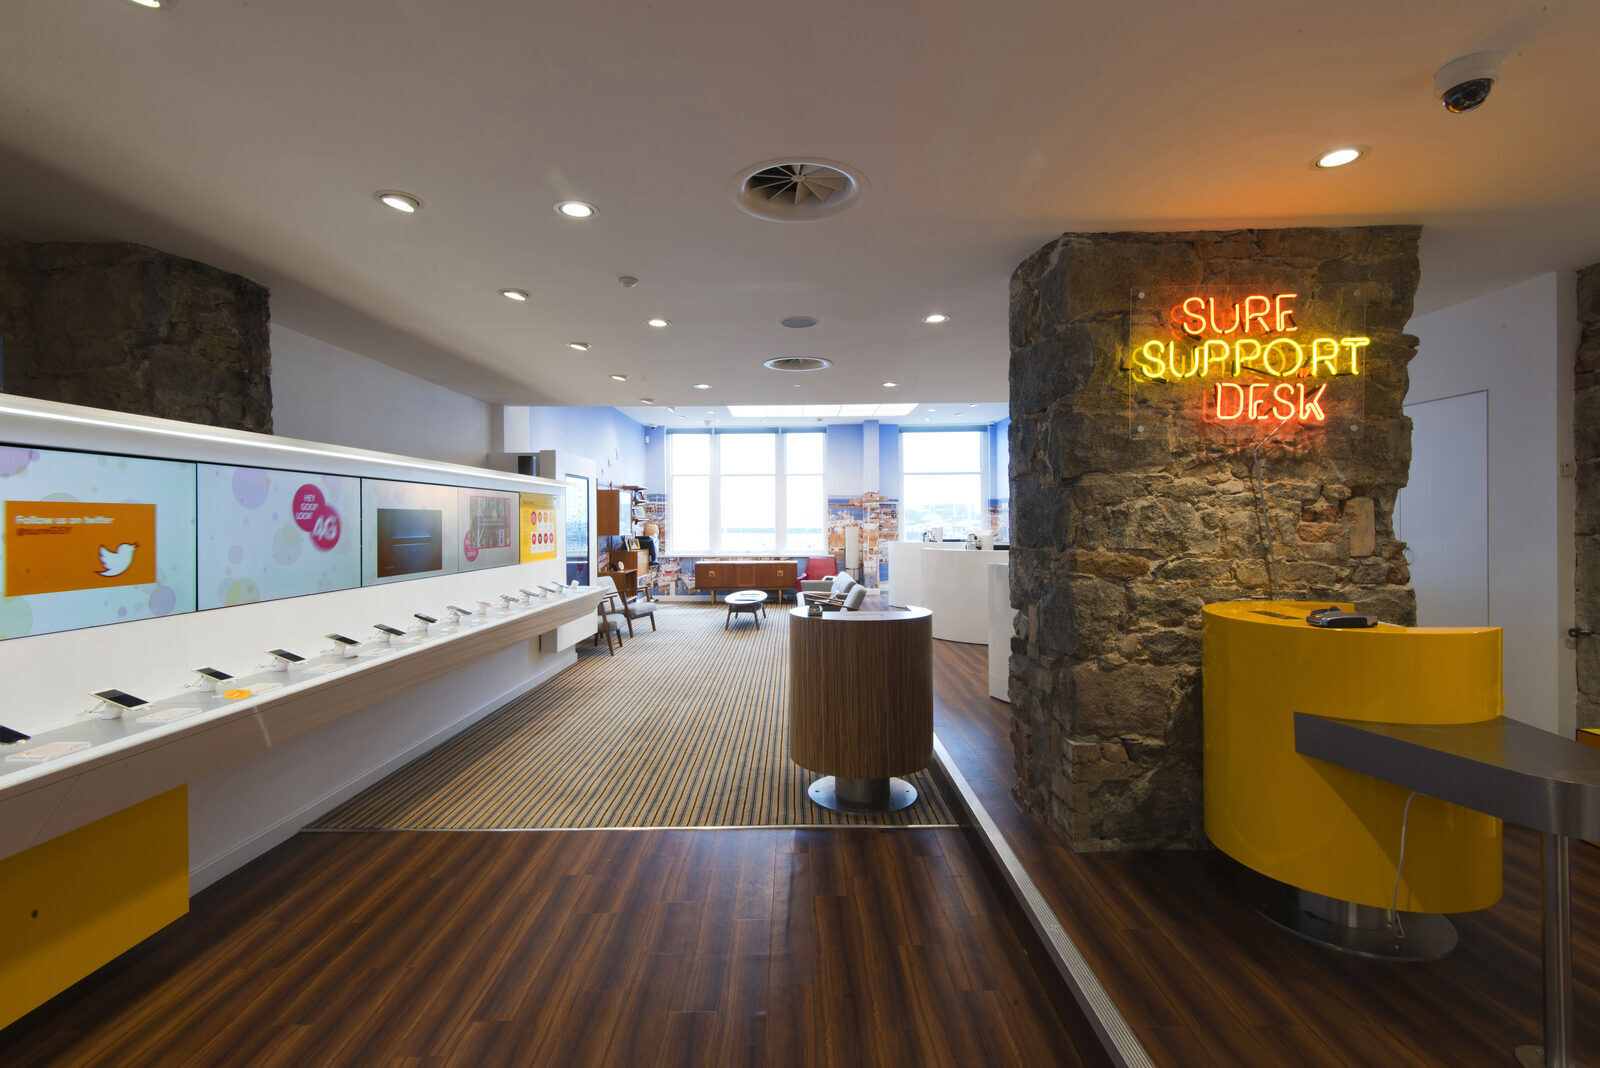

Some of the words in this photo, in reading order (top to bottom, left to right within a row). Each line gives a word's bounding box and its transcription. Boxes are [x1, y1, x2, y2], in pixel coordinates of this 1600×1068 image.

[1182, 293, 1298, 335] SURE
[1141, 337, 1370, 378] SUPPORT
[1215, 382, 1328, 421] DESK
[312, 515, 337, 541] 4G
